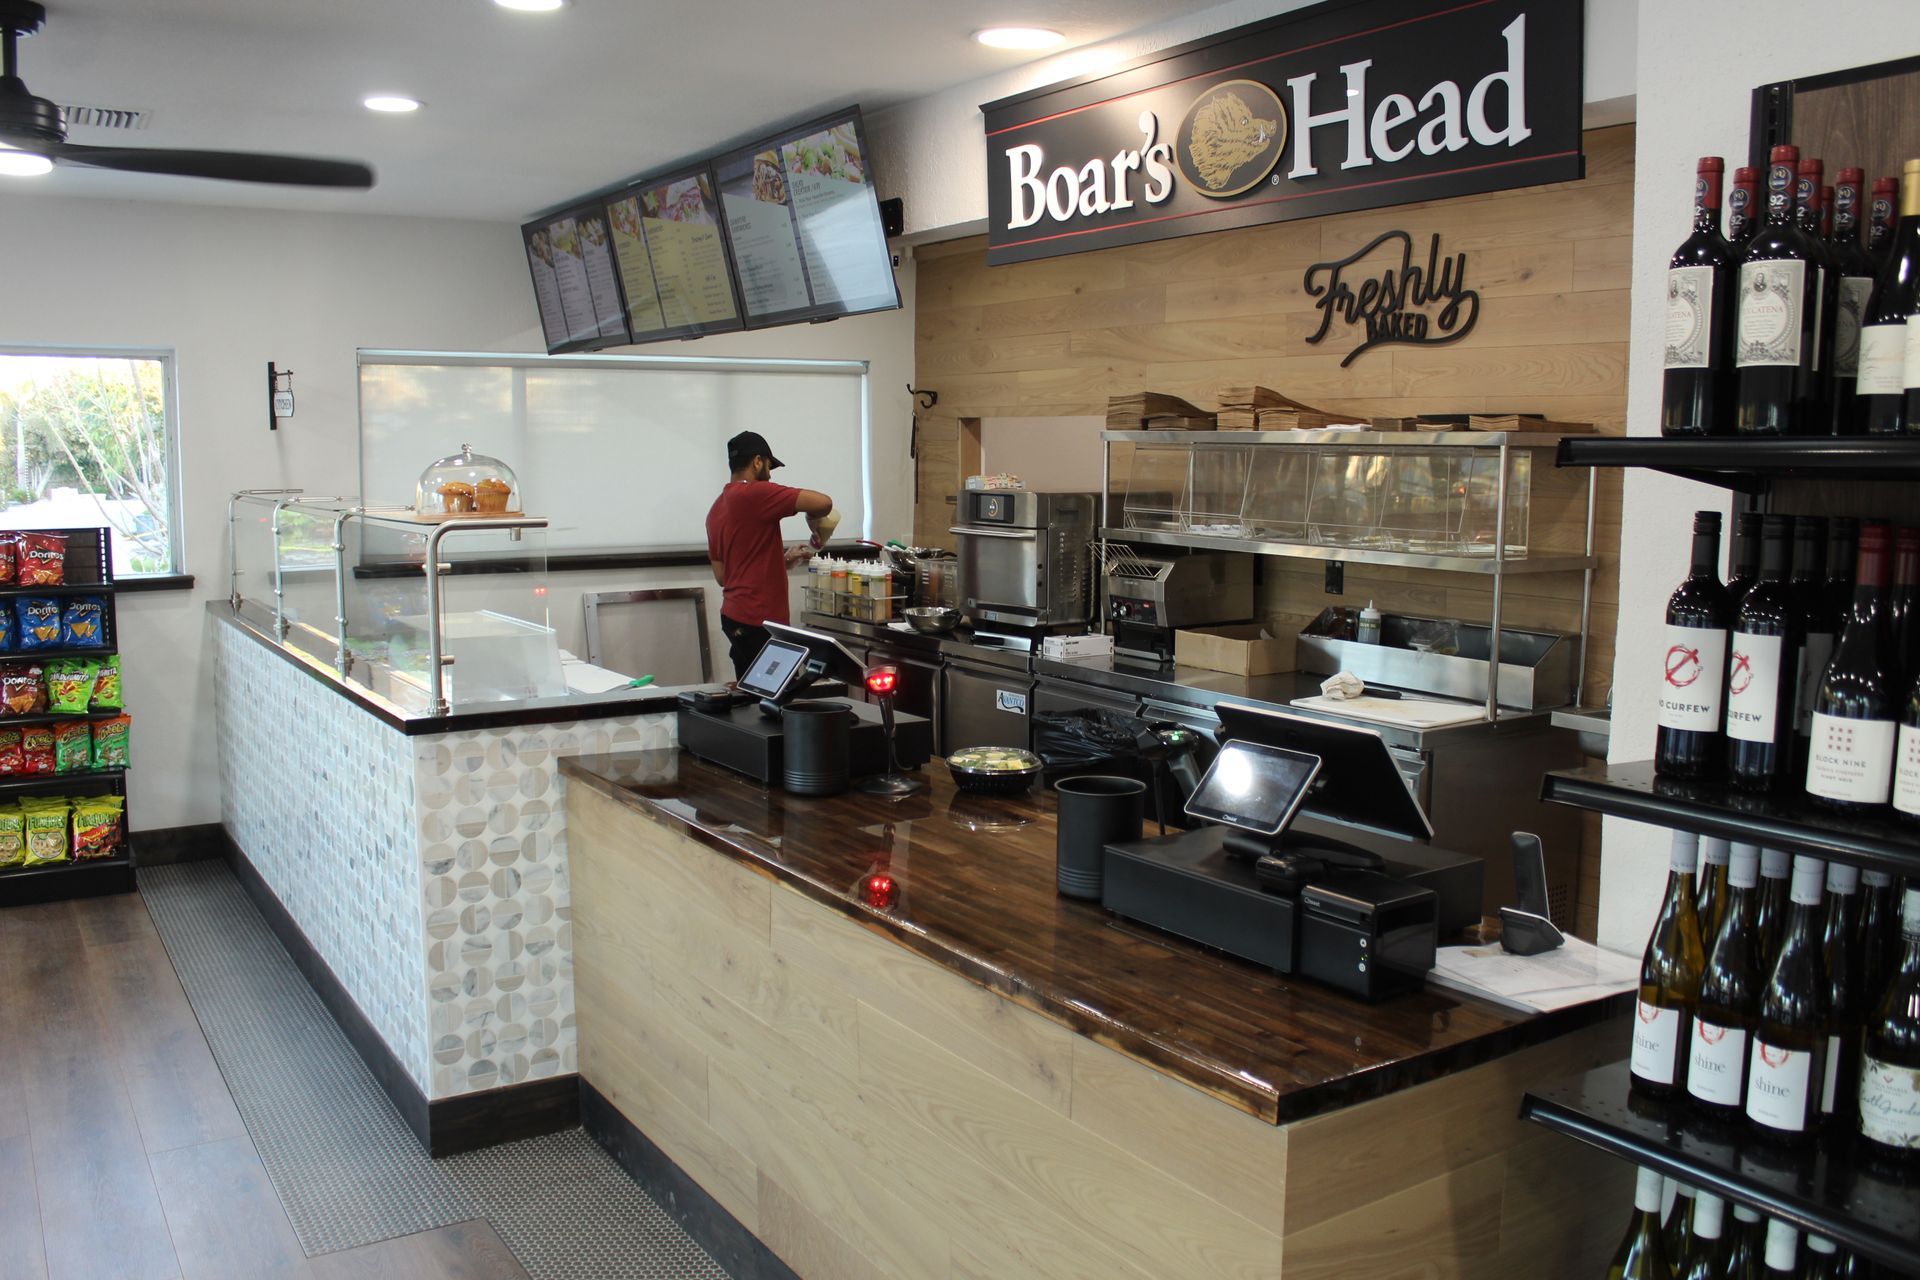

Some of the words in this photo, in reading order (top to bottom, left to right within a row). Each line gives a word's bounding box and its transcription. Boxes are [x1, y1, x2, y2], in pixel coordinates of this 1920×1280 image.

[1005, 110, 1174, 230] Boar's
[1286, 13, 1533, 181] Head
[1304, 230, 1480, 367] Freshly
[1366, 312, 1429, 342] BAKED
[29, 550, 64, 560] Doritos
[1666, 701, 1710, 713] CURFEW
[1842, 760, 1867, 769] NINE
[1694, 1053, 1726, 1074] shine
[1755, 1076, 1790, 1098] shine
